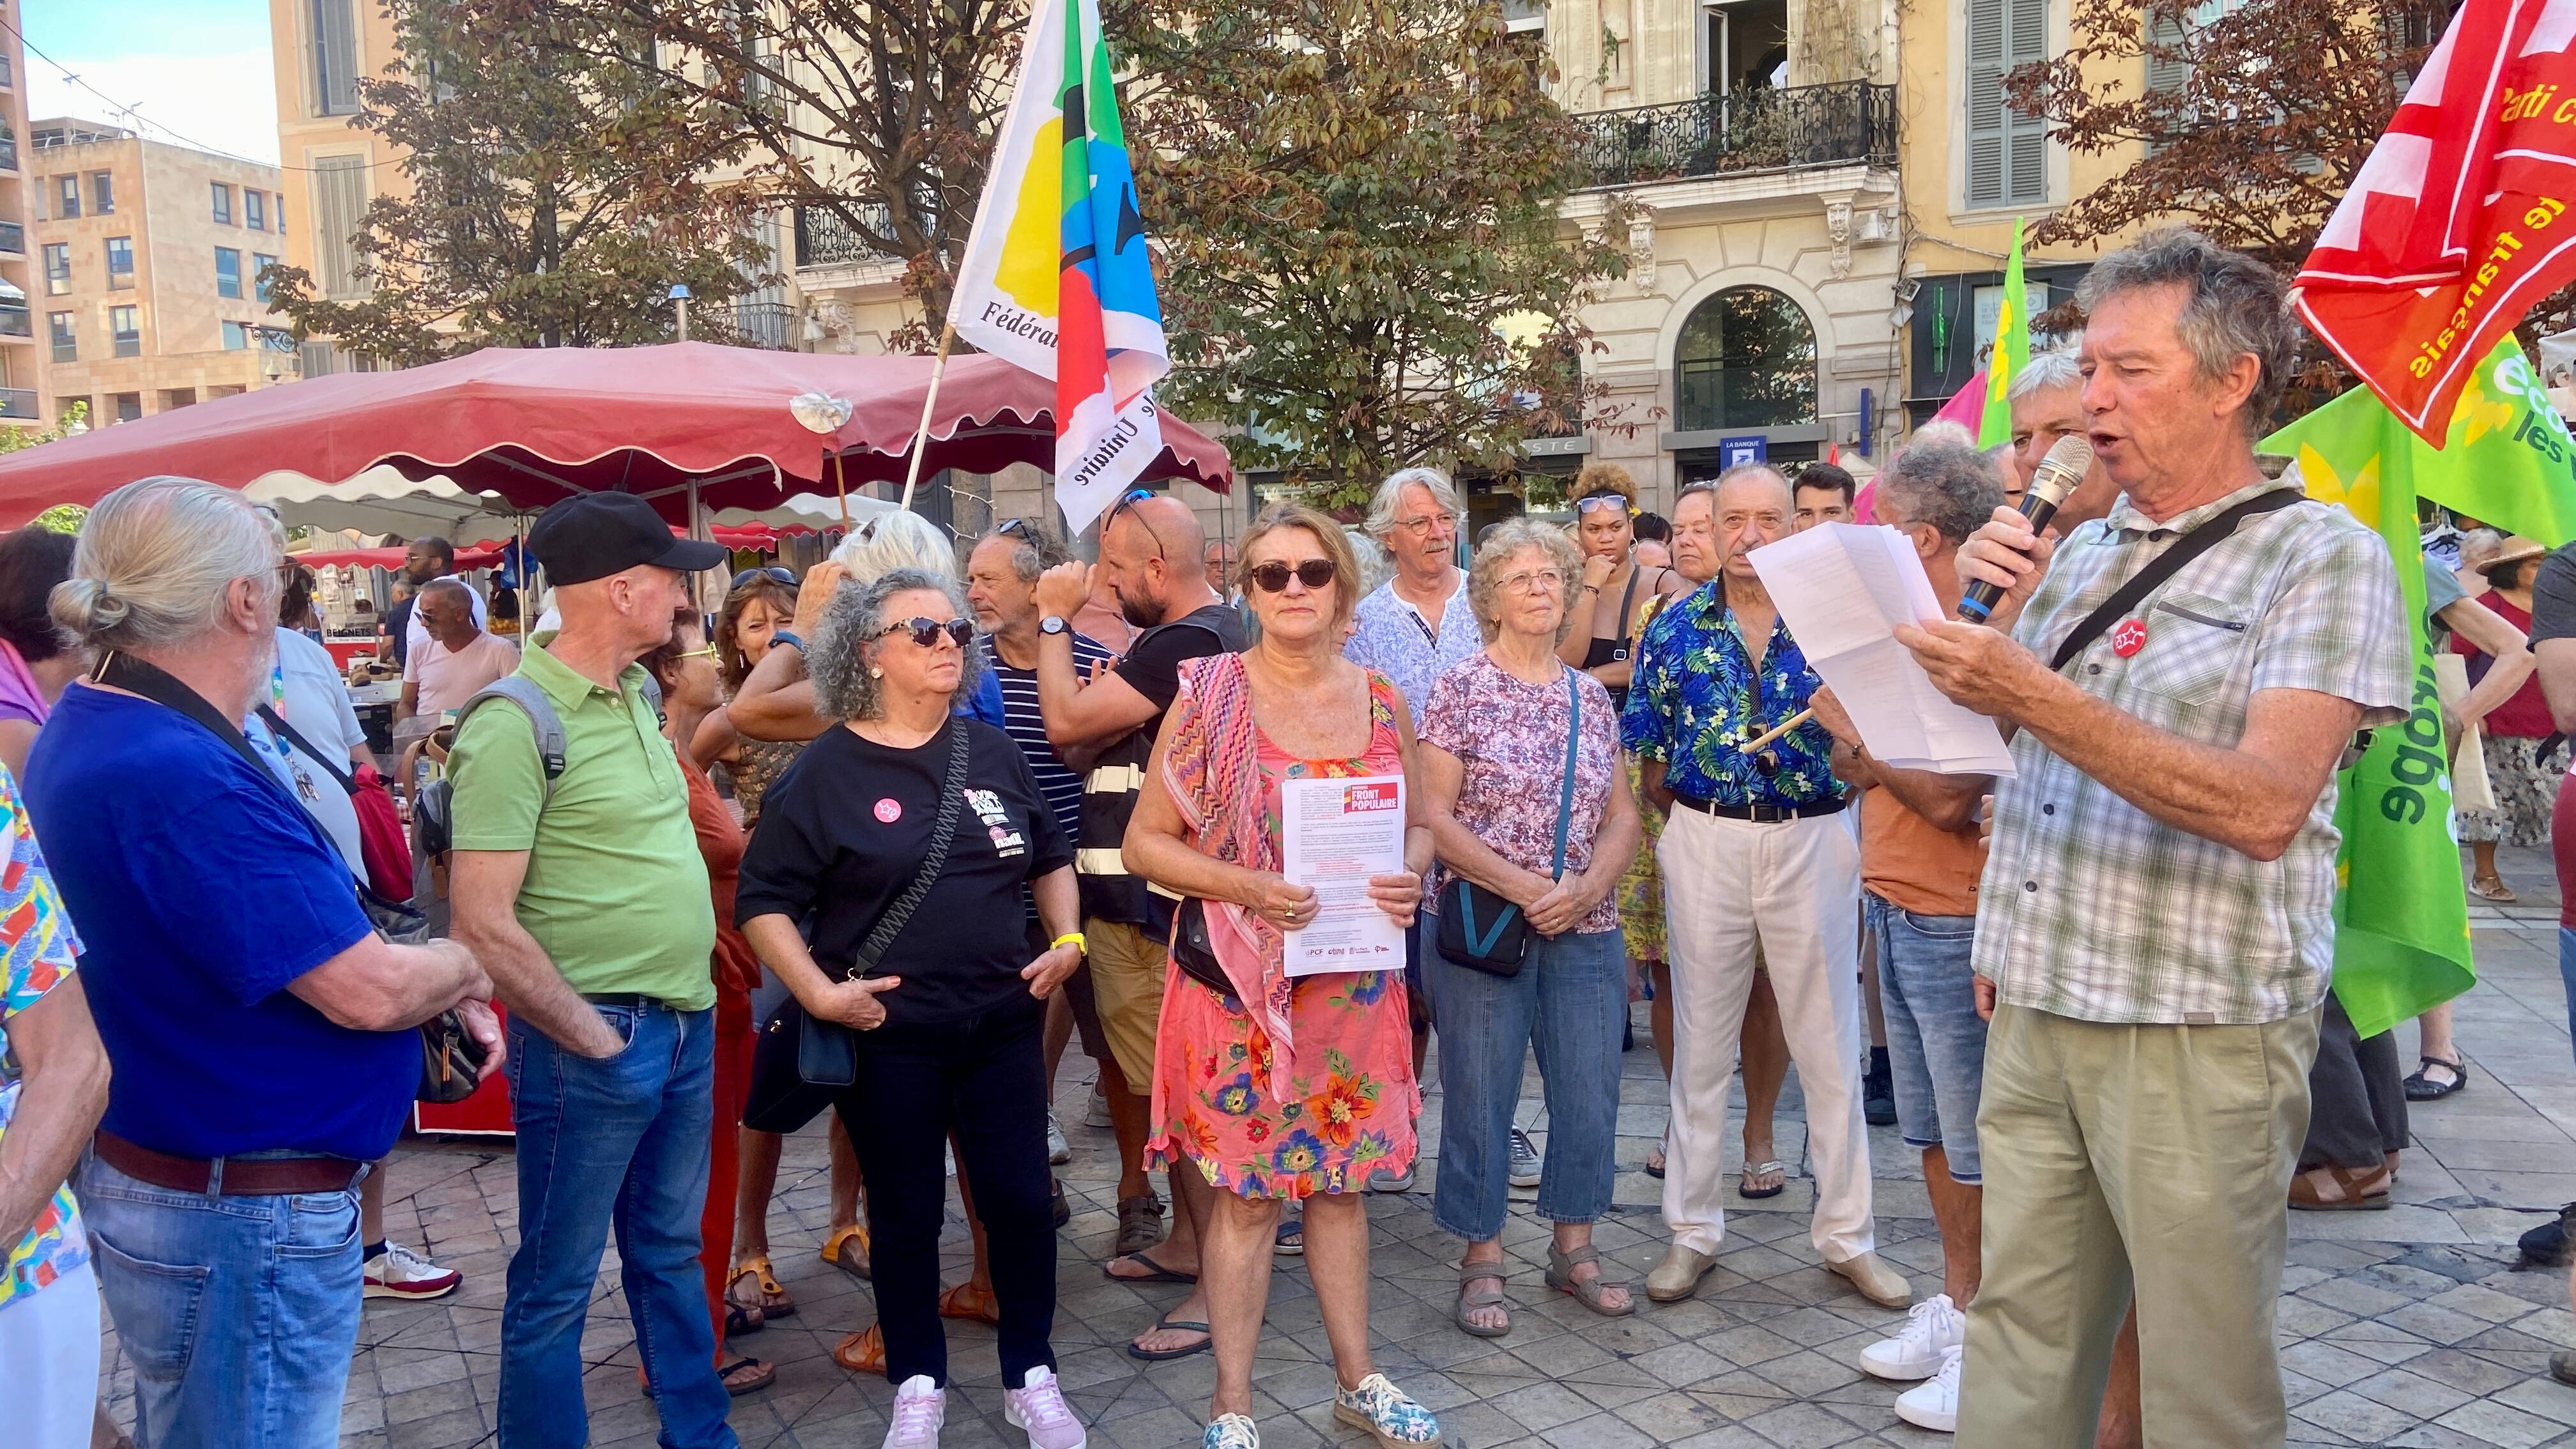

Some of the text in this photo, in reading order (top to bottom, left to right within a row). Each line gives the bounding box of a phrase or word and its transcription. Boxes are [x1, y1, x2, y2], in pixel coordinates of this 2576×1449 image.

[2513, 409, 2563, 463] les
[326, 628, 371, 637] BEIGNETS
[1351, 789, 1379, 800] FRONT
[1351, 798, 1397, 811] POPULAIRE
